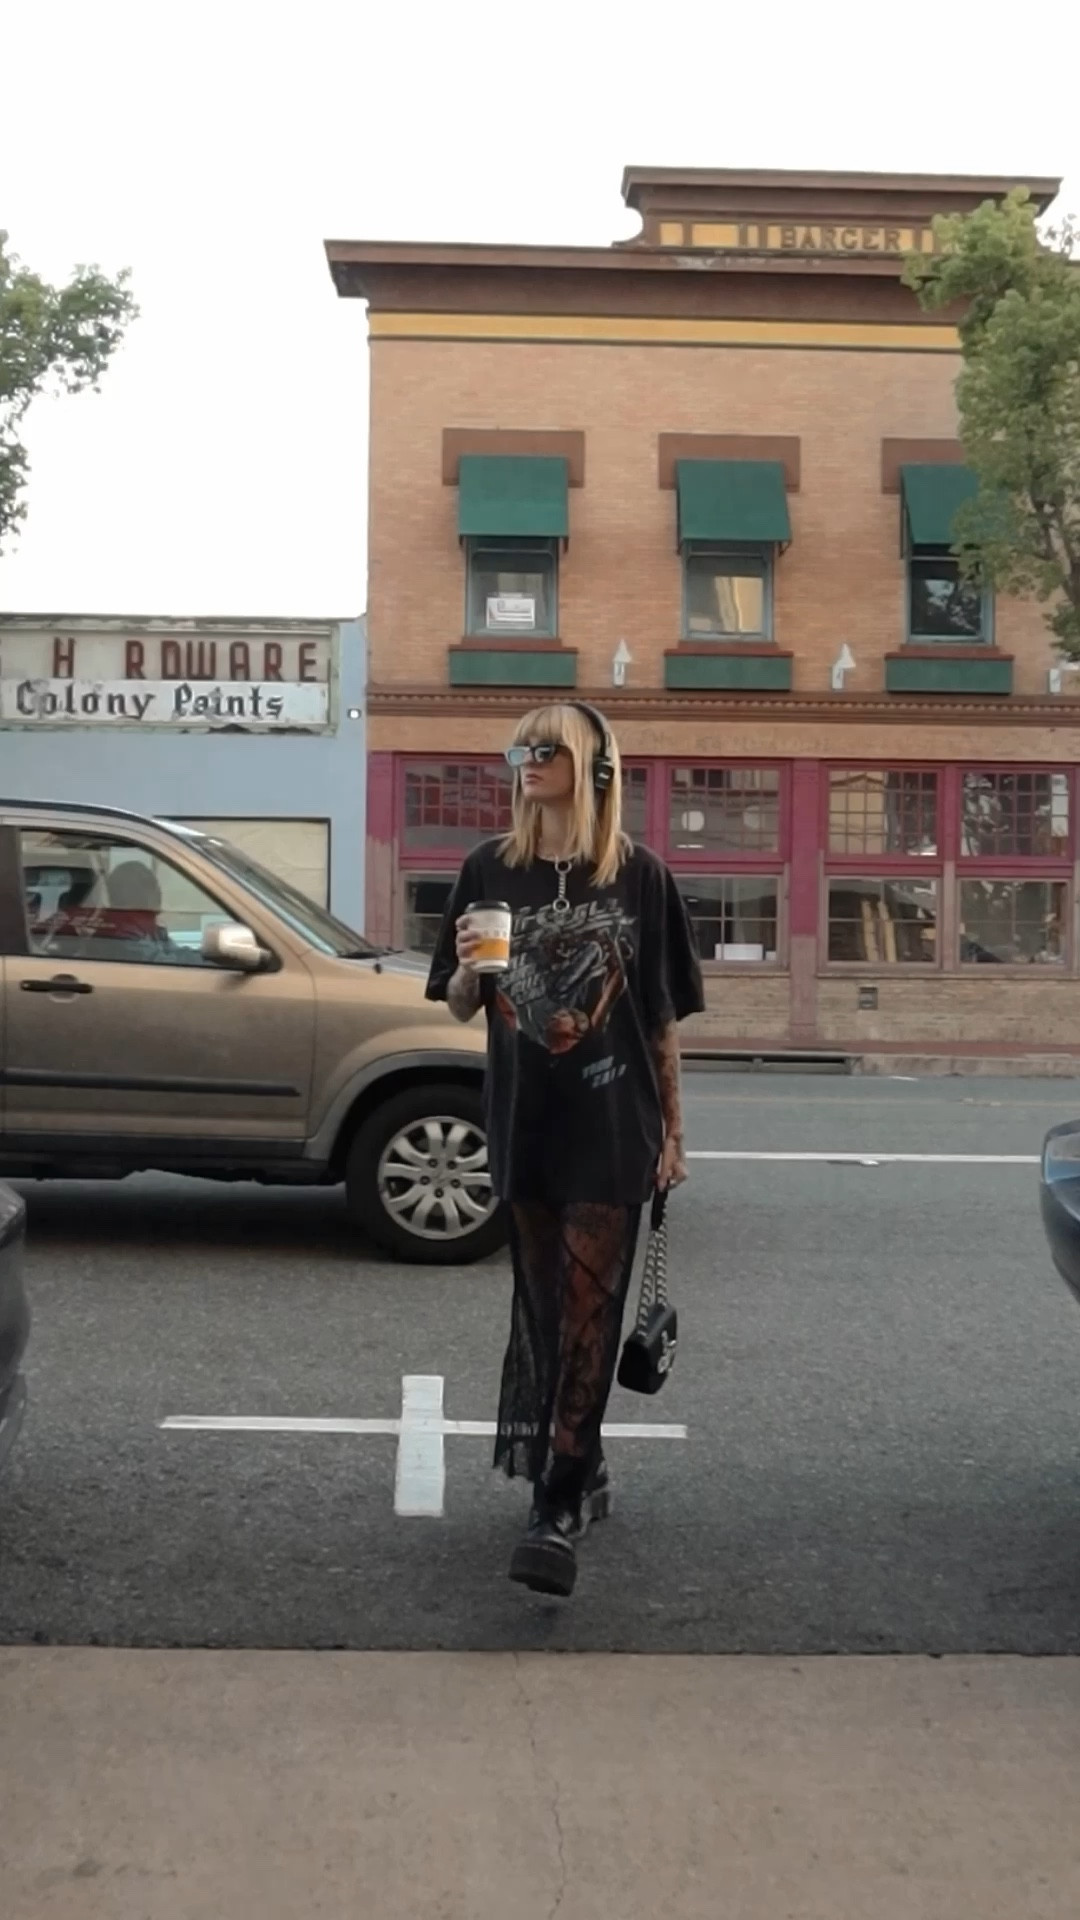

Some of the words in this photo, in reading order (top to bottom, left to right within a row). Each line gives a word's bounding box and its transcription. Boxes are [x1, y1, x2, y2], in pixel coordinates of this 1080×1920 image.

[780, 225, 901, 251] BARGER
[16, 680, 154, 719] Colony
[172, 682, 285, 719] Paints
